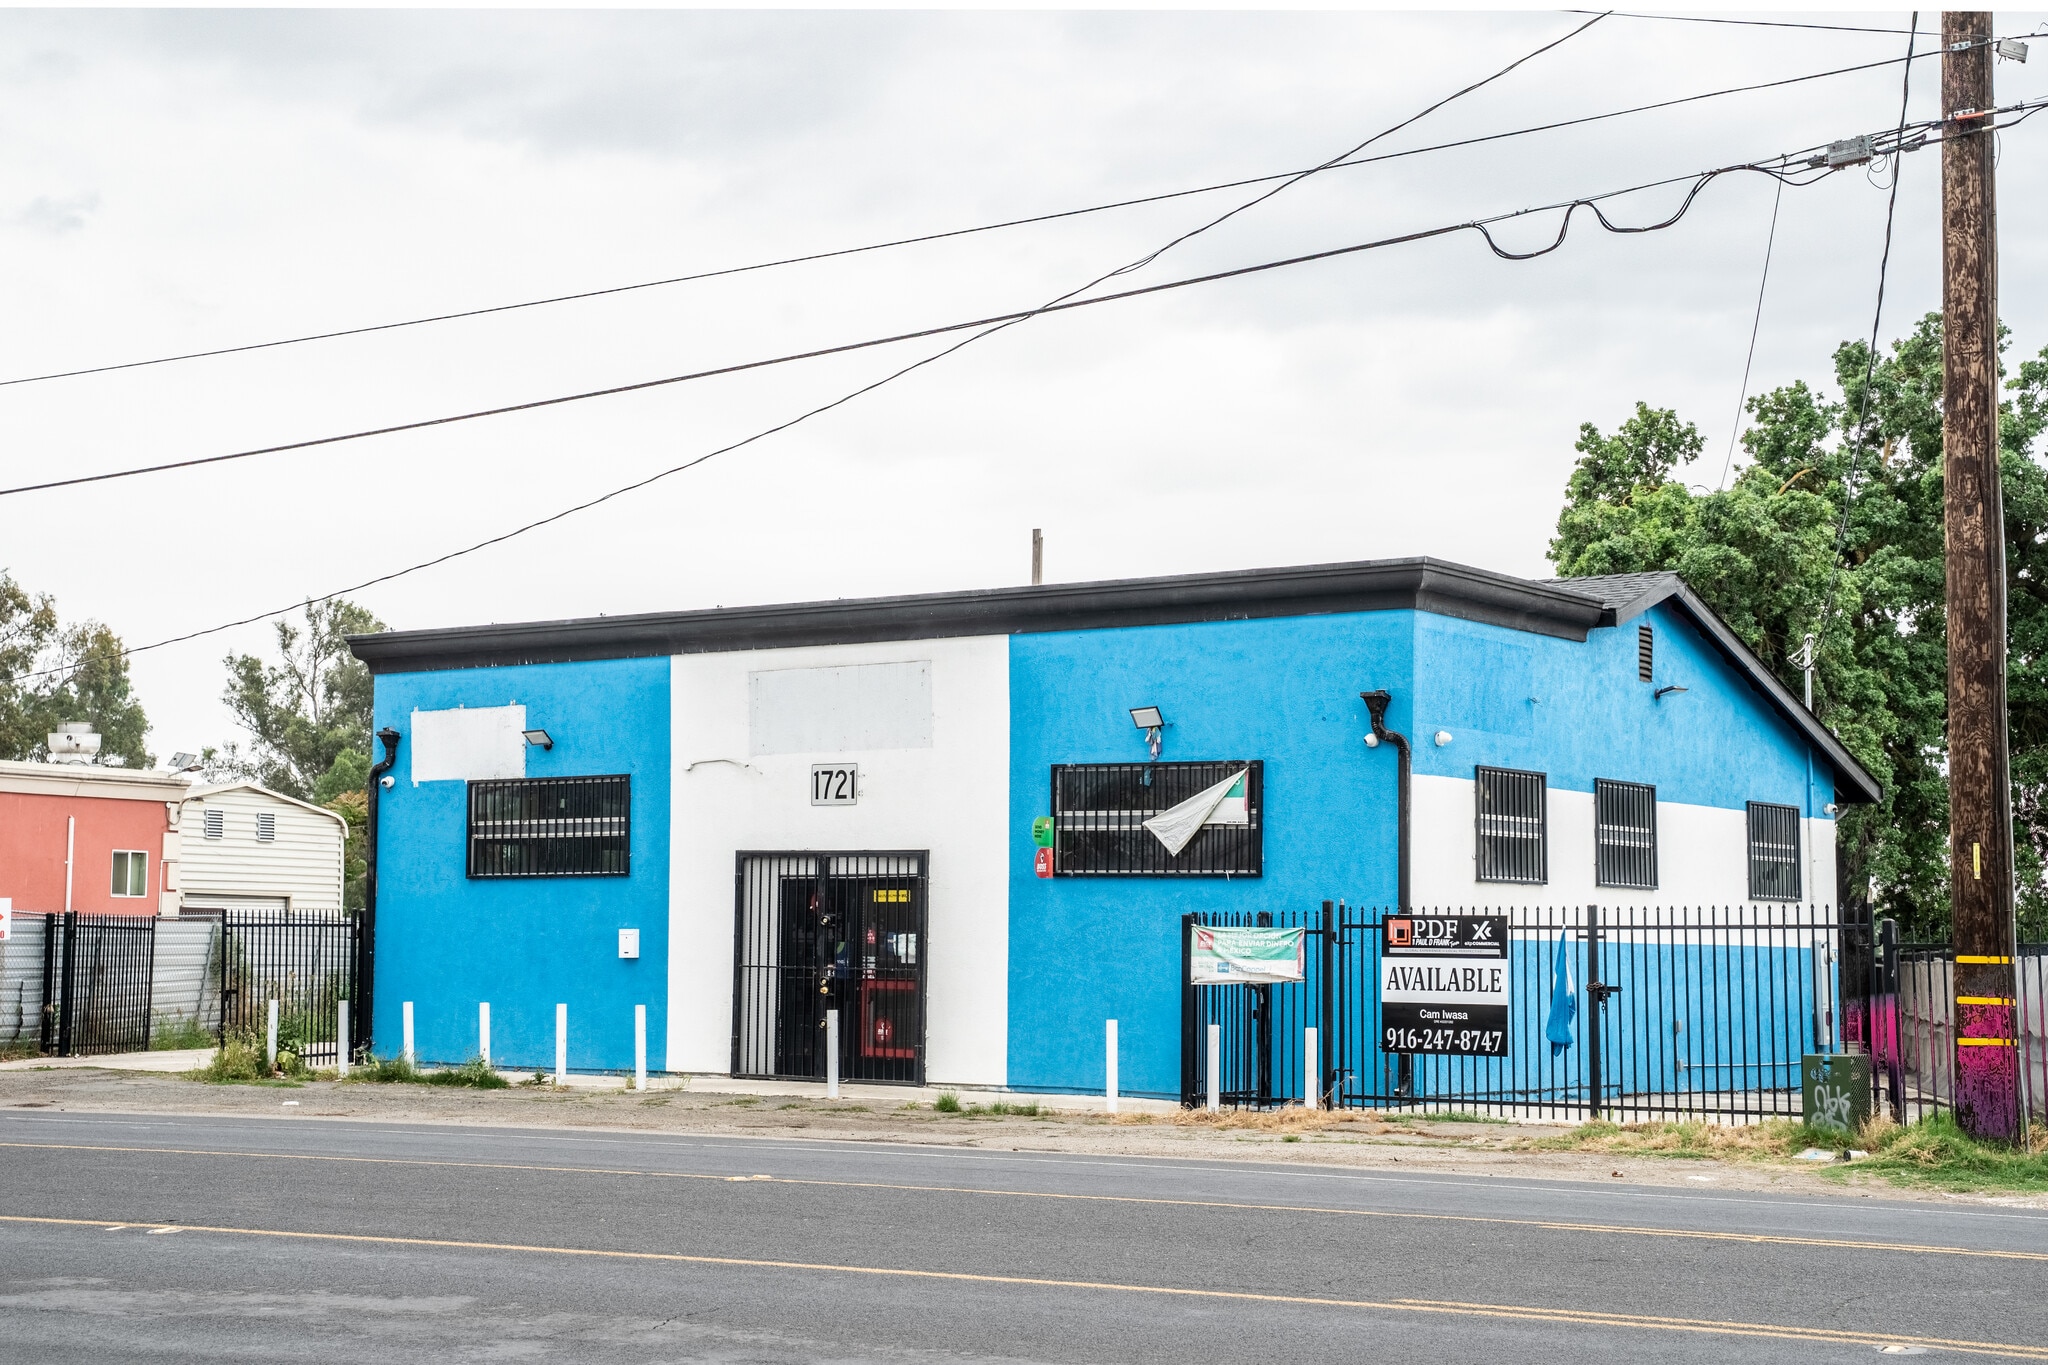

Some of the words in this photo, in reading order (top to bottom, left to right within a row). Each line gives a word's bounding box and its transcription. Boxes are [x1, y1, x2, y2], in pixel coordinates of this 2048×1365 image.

[814, 770, 855, 800] 1721
[1412, 919, 1458, 939] PDF
[1217, 939, 1236, 947] PARA
[1433, 939, 1450, 947] FRANK
[1386, 966, 1502, 993] AVAILABLE
[1420, 1009, 1440, 1019] Cam
[1442, 1010, 1469, 1020] Iwasa
[1386, 1027, 1503, 1052] 916-247-8747
